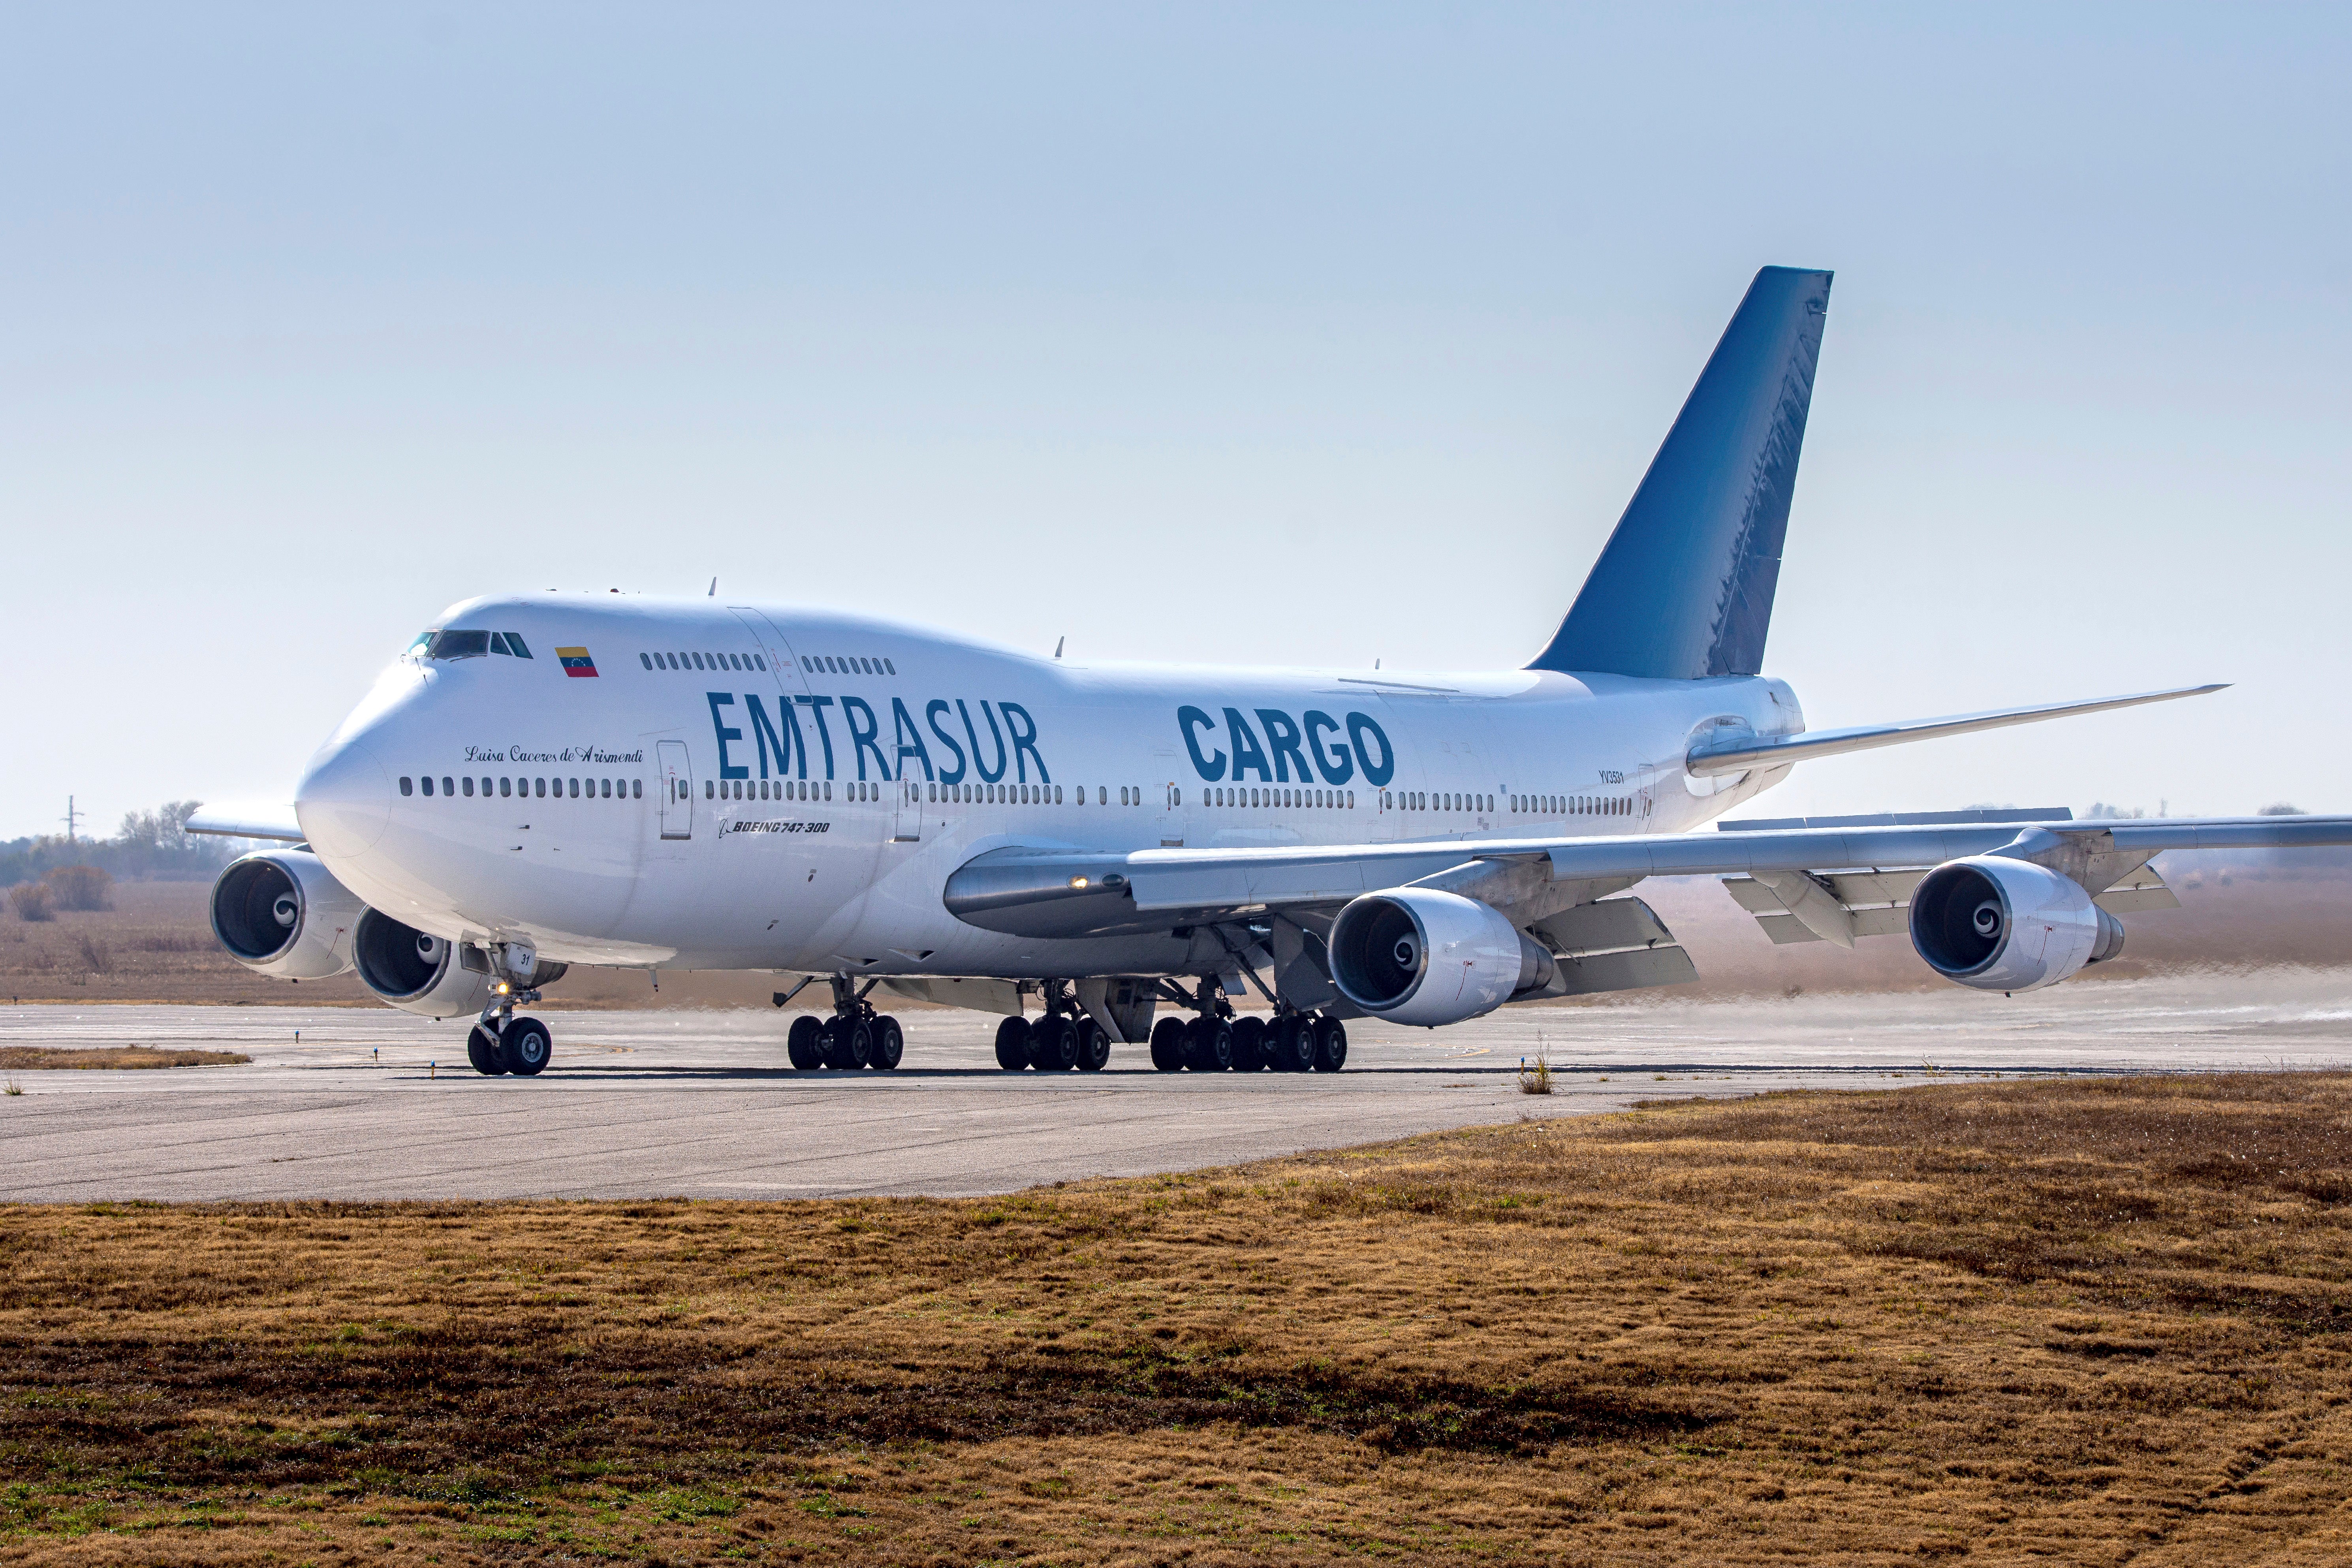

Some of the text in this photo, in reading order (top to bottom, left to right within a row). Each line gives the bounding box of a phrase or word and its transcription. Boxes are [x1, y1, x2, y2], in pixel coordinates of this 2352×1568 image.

[706, 692, 1394, 787] EMTRASUR CARGO
[465, 745, 643, 763] Luisa Caceres de Arismendi
[1598, 770, 1624, 784] YV3531
[732, 822, 830, 833] BOEING 747-300
[521, 953, 530, 966] 31
